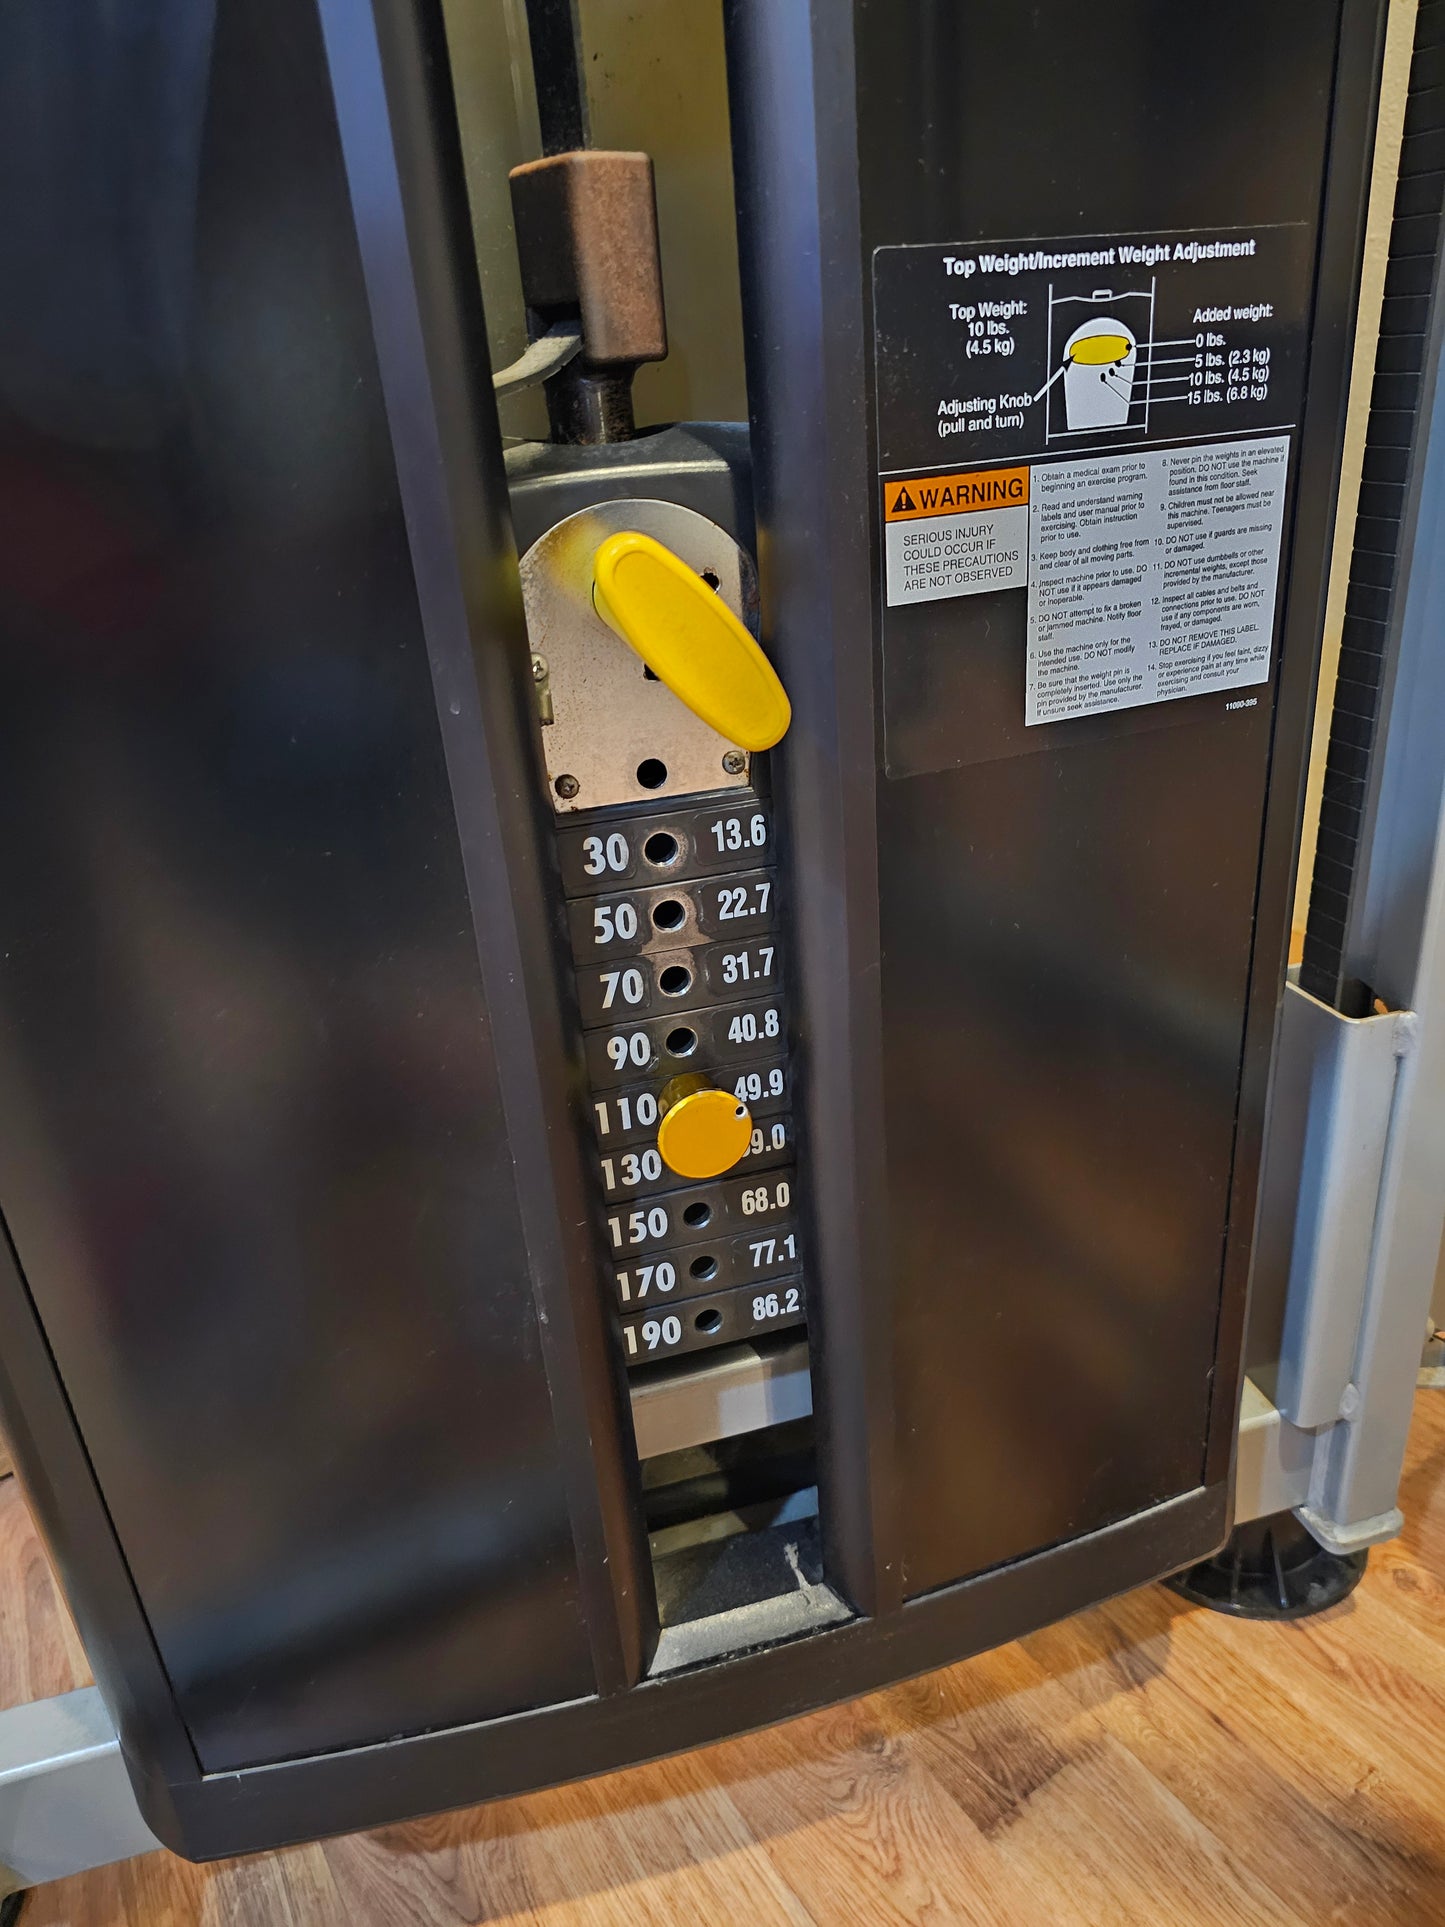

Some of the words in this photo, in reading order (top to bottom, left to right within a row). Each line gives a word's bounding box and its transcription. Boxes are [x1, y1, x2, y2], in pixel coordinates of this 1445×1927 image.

[943, 257, 976, 278] Top
[979, 248, 1115, 275] Weight/Increment
[1118, 243, 1171, 266] Weight
[1173, 239, 1256, 263] Adjustment
[949, 304, 975, 322] Top
[978, 300, 1027, 319] Weight:
[1193, 306, 1231, 323] Added
[1234, 303, 1273, 322] weight:
[968, 321, 984, 336] 10
[987, 320, 1010, 335] lbs.
[966, 339, 991, 359] (4.5
[994, 337, 1015, 356] kg)
[1196, 333, 1203, 348] 0
[1206, 332, 1226, 347] lbs.
[1195, 353, 1203, 368] 5
[1206, 352, 1225, 366] lbs.
[1229, 349, 1250, 367] (2.3
[1253, 347, 1270, 365] kg)
[1189, 372, 1202, 386] 10
[1205, 371, 1224, 384] lbs.
[1228, 367, 1249, 385] (4.5
[1252, 365, 1269, 382] kg)
[937, 397, 996, 417] Adjusting
[1000, 392, 1032, 409] Knob
[1188, 391, 1201, 405] 15
[1204, 389, 1223, 403] lbs.
[1227, 386, 1247, 403] (6.8
[1251, 384, 1267, 401] kg)
[938, 418, 965, 438] (pull
[968, 415, 992, 431] and
[995, 412, 1024, 429] turn)
[1041, 471, 1065, 480] Obtain
[1072, 467, 1099, 477] medical
[1121, 463, 1137, 472] prior
[919, 476, 1022, 510] WARNING
[1040, 480, 1075, 493] beginning
[1087, 476, 1115, 485] exercise
[1117, 474, 1147, 483] program.
[1040, 512, 1061, 521] labels
[1063, 510, 1076, 518] and
[1094, 505, 1119, 514] manual
[1121, 502, 1136, 512] prior
[1041, 502, 1060, 510] Read
[1061, 500, 1075, 508] and
[1076, 495, 1115, 506] understand
[1116, 492, 1142, 502] warning
[1167, 499, 1195, 509] Children
[1196, 497, 1212, 505] must
[1235, 491, 1259, 500] allowed
[1040, 520, 1078, 533] exercising.
[1079, 517, 1101, 526] Obtain
[1103, 512, 1137, 522] instruction
[1178, 534, 1192, 542] NOT
[1213, 528, 1235, 538] guards
[1248, 523, 1272, 533] missing
[903, 529, 951, 546] SERIOUS
[955, 524, 993, 539] INJURY
[903, 546, 941, 561] COULD
[944, 540, 983, 555] OCCUR
[986, 538, 996, 549] IF
[1039, 551, 1057, 561] Keep
[1059, 548, 1076, 558] body
[1077, 546, 1090, 554] and
[1092, 542, 1118, 554] clothing
[1119, 540, 1132, 548] free
[1134, 538, 1149, 546] from
[1053, 559, 1070, 567] clear
[1090, 553, 1114, 564] moving
[1115, 550, 1134, 560] parts.
[1173, 542, 1205, 554] damaged.
[1206, 552, 1238, 562] dumbbells
[1247, 548, 1263, 556] other
[903, 561, 939, 576] THESE
[943, 550, 1018, 571] PRECAUTIONS
[903, 578, 925, 591] ARE
[929, 574, 951, 587] NOT
[954, 565, 1012, 583] OBSERVED
[1038, 614, 1050, 622] DO
[1051, 612, 1066, 620] NOT
[1069, 607, 1094, 618] attempt
[1119, 600, 1141, 609] broken
[1159, 638, 1170, 646] DO
[1171, 636, 1187, 644] NOT
[1188, 630, 1218, 641] REMOVE
[1219, 628, 1235, 636] THIS
[1236, 624, 1259, 632] LABEL.
[1159, 644, 1191, 655] REPLACE
[1200, 636, 1237, 648] DAMAGED.
[1064, 676, 1077, 684] that
[1090, 670, 1111, 680] weight
[1112, 668, 1122, 677] pin
[711, 814, 766, 852] 13.6
[583, 833, 629, 876] 30
[717, 883, 771, 920] 22.7
[594, 903, 638, 943] 50
[722, 947, 774, 983] 31.7
[600, 969, 644, 1008] 70
[728, 1009, 780, 1043] 40.8
[607, 1032, 650, 1070] 90
[734, 1069, 783, 1102] 49.9
[594, 1092, 657, 1134] 110
[743, 1124, 785, 1157] 9.0
[601, 1149, 662, 1190] 130
[741, 1182, 790, 1215] 68.0
[608, 1207, 668, 1247] 150
[750, 1234, 796, 1267] 77.1
[616, 1262, 676, 1301] 170
[753, 1288, 799, 1320] 86.2
[623, 1316, 682, 1354] 190
